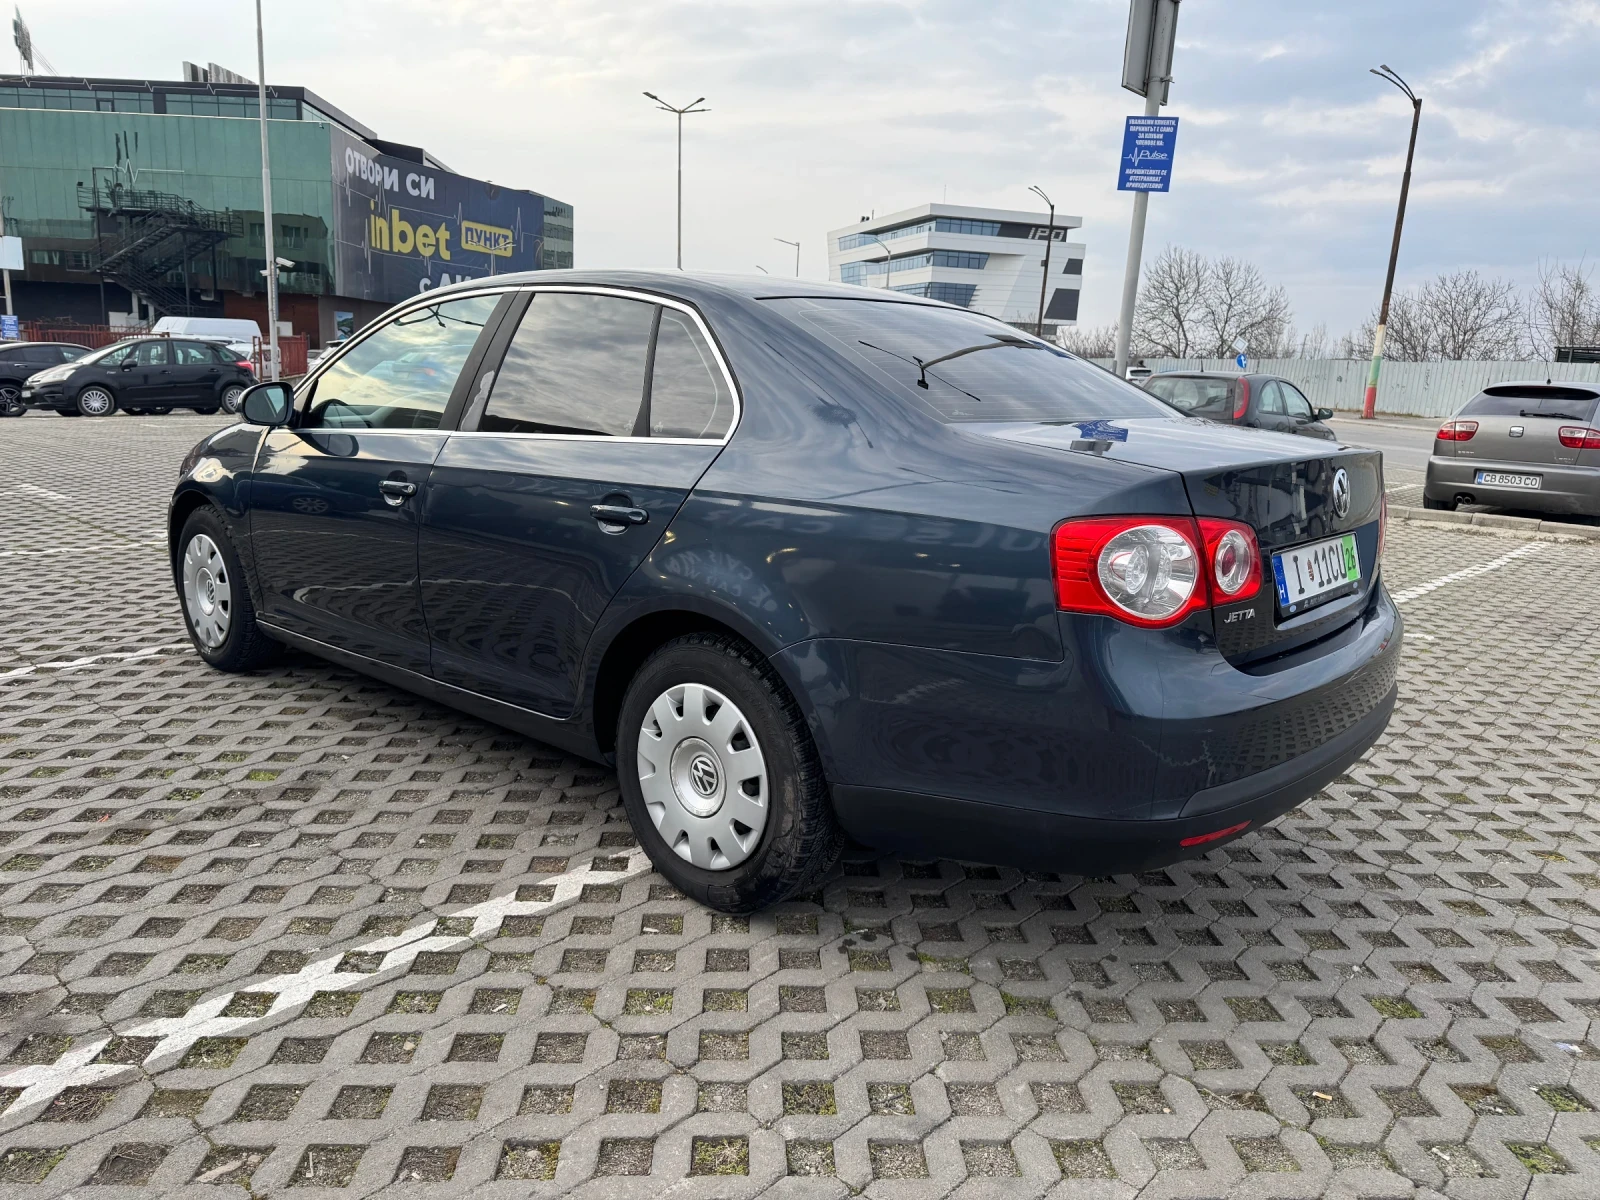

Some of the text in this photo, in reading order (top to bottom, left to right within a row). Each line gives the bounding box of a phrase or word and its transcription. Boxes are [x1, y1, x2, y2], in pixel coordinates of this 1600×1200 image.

[1140, 149, 1168, 159] Pulse
[345, 147, 435, 200] ОТВОРИ СИ
[370, 199, 450, 261] inbet
[465, 226, 510, 251] ПУНКТ
[1028, 227, 1065, 241] IPO
[1483, 473, 1538, 487] CB 8503 CO
[1345, 546, 1357, 571] 26
[1223, 608, 1256, 624] JETTA
